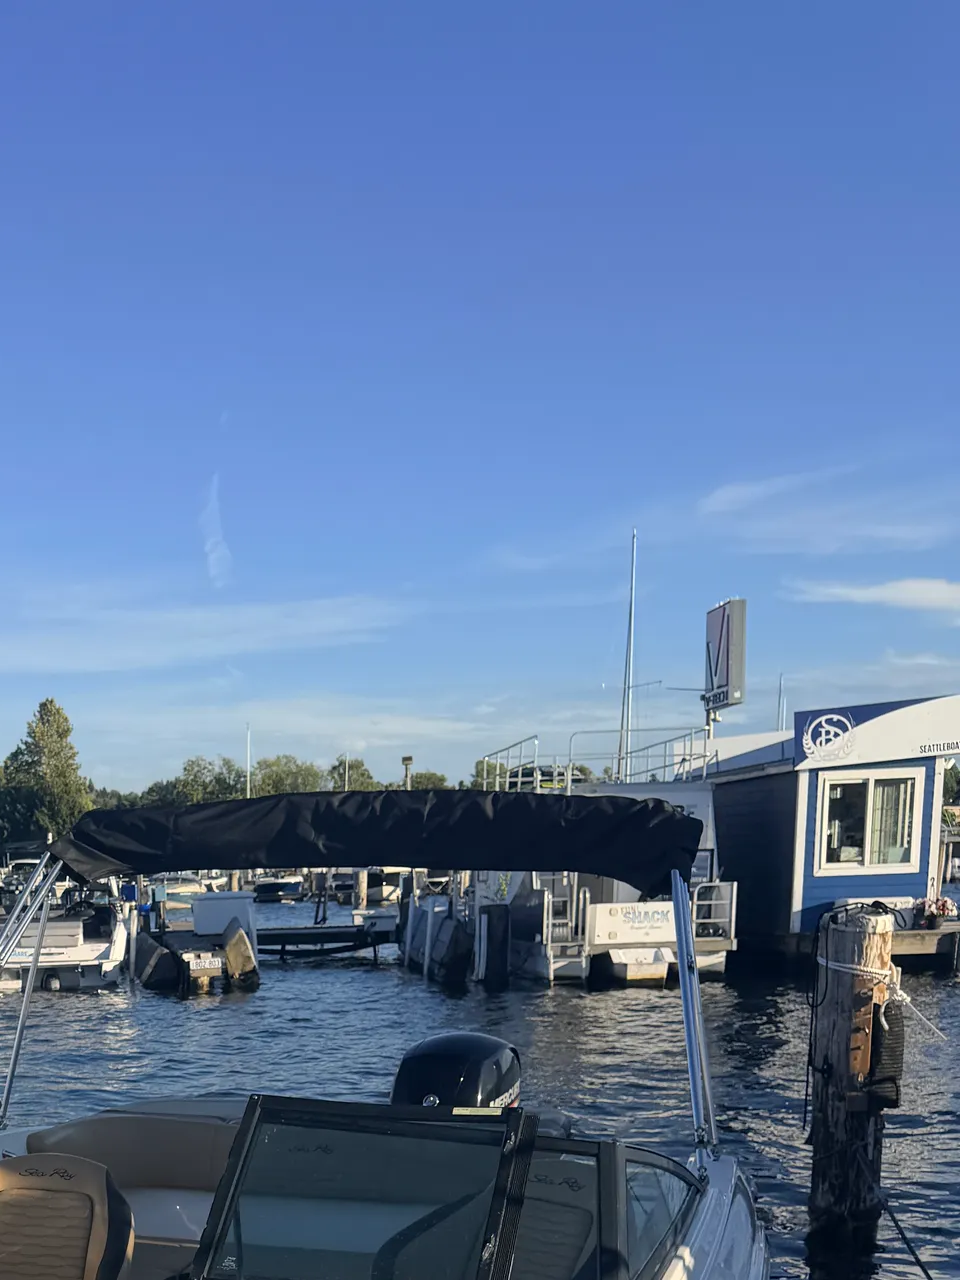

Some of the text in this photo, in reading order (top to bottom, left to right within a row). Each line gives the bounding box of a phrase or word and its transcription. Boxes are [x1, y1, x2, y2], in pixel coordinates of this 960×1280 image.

[919, 741, 960, 754] SEATTLEBOA
[622, 910, 670, 924] SHACK
[490, 1078, 521, 1108] MERCUR
[18, 1167, 77, 1180] Sea Ray
[558, 1177, 587, 1192] Ray
